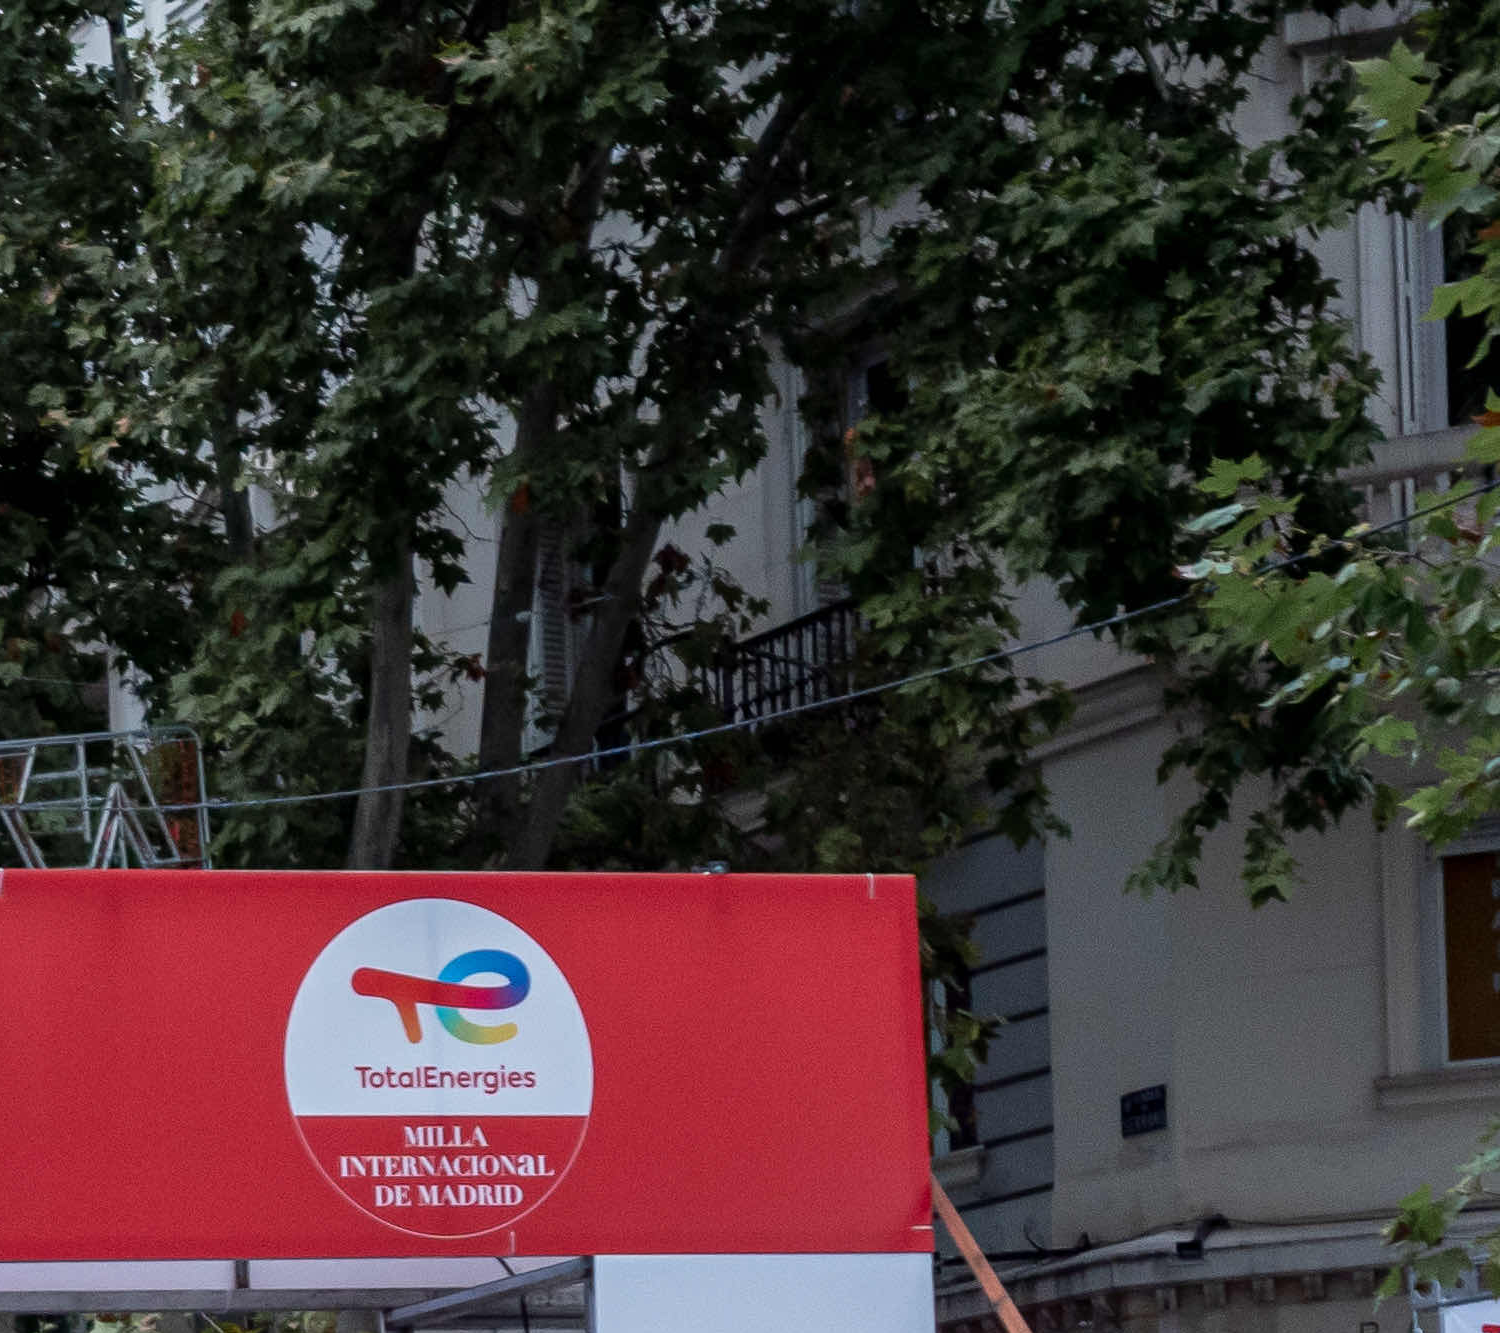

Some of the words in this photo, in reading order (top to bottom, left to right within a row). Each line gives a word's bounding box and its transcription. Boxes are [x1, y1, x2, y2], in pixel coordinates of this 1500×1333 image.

[354, 1063, 538, 1095] TotalEnergies
[402, 1124, 490, 1149] MILLA
[373, 1182, 412, 1207] DE
[417, 1182, 524, 1207] MADRID
